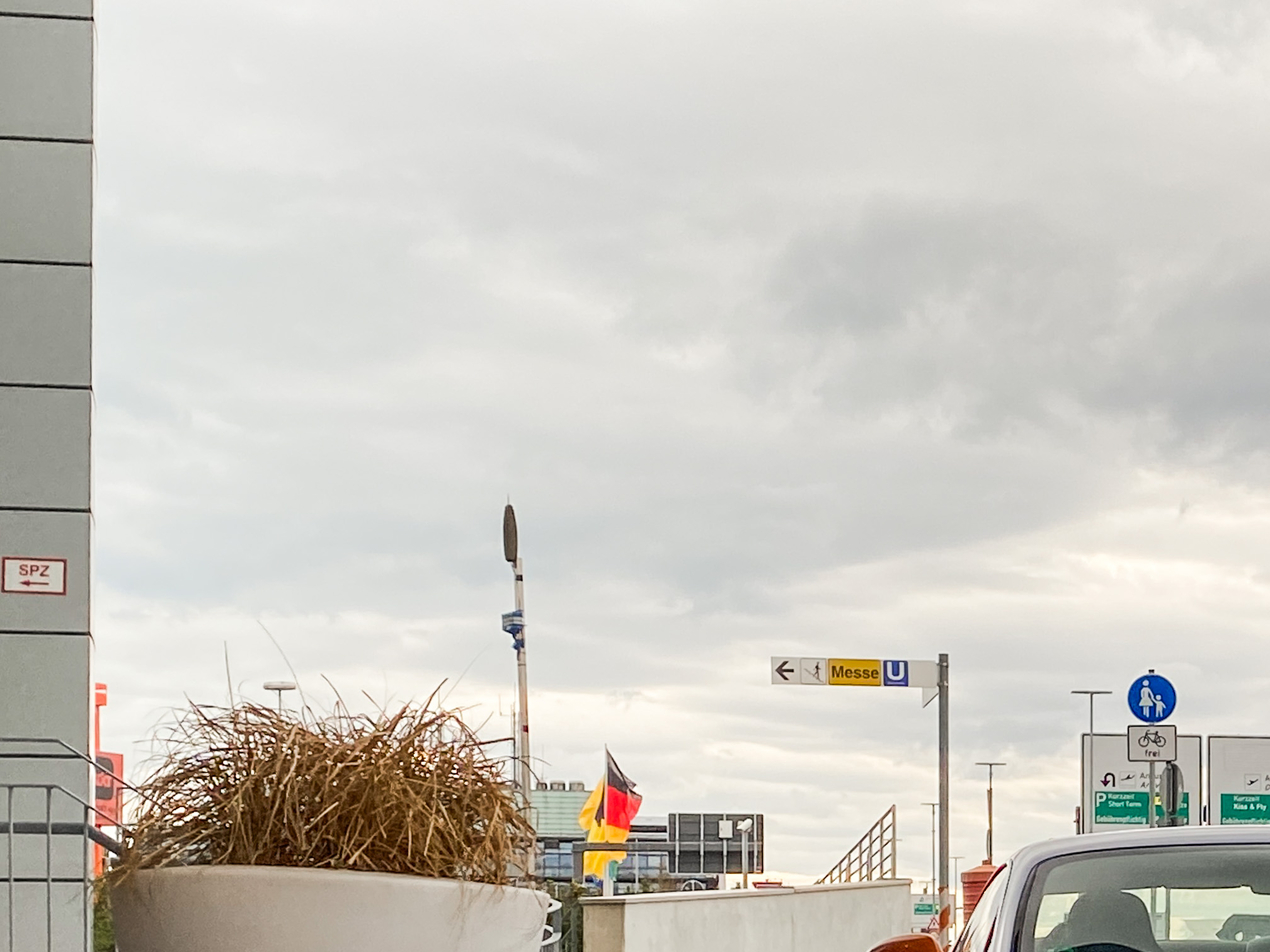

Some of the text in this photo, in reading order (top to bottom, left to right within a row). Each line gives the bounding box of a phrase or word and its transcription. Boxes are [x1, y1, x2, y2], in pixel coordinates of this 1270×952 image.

[18, 564, 50, 577] SPZ
[831, 660, 905, 681] Messe U
[1144, 749, 1161, 758] frei
[1096, 793, 1107, 807] P
